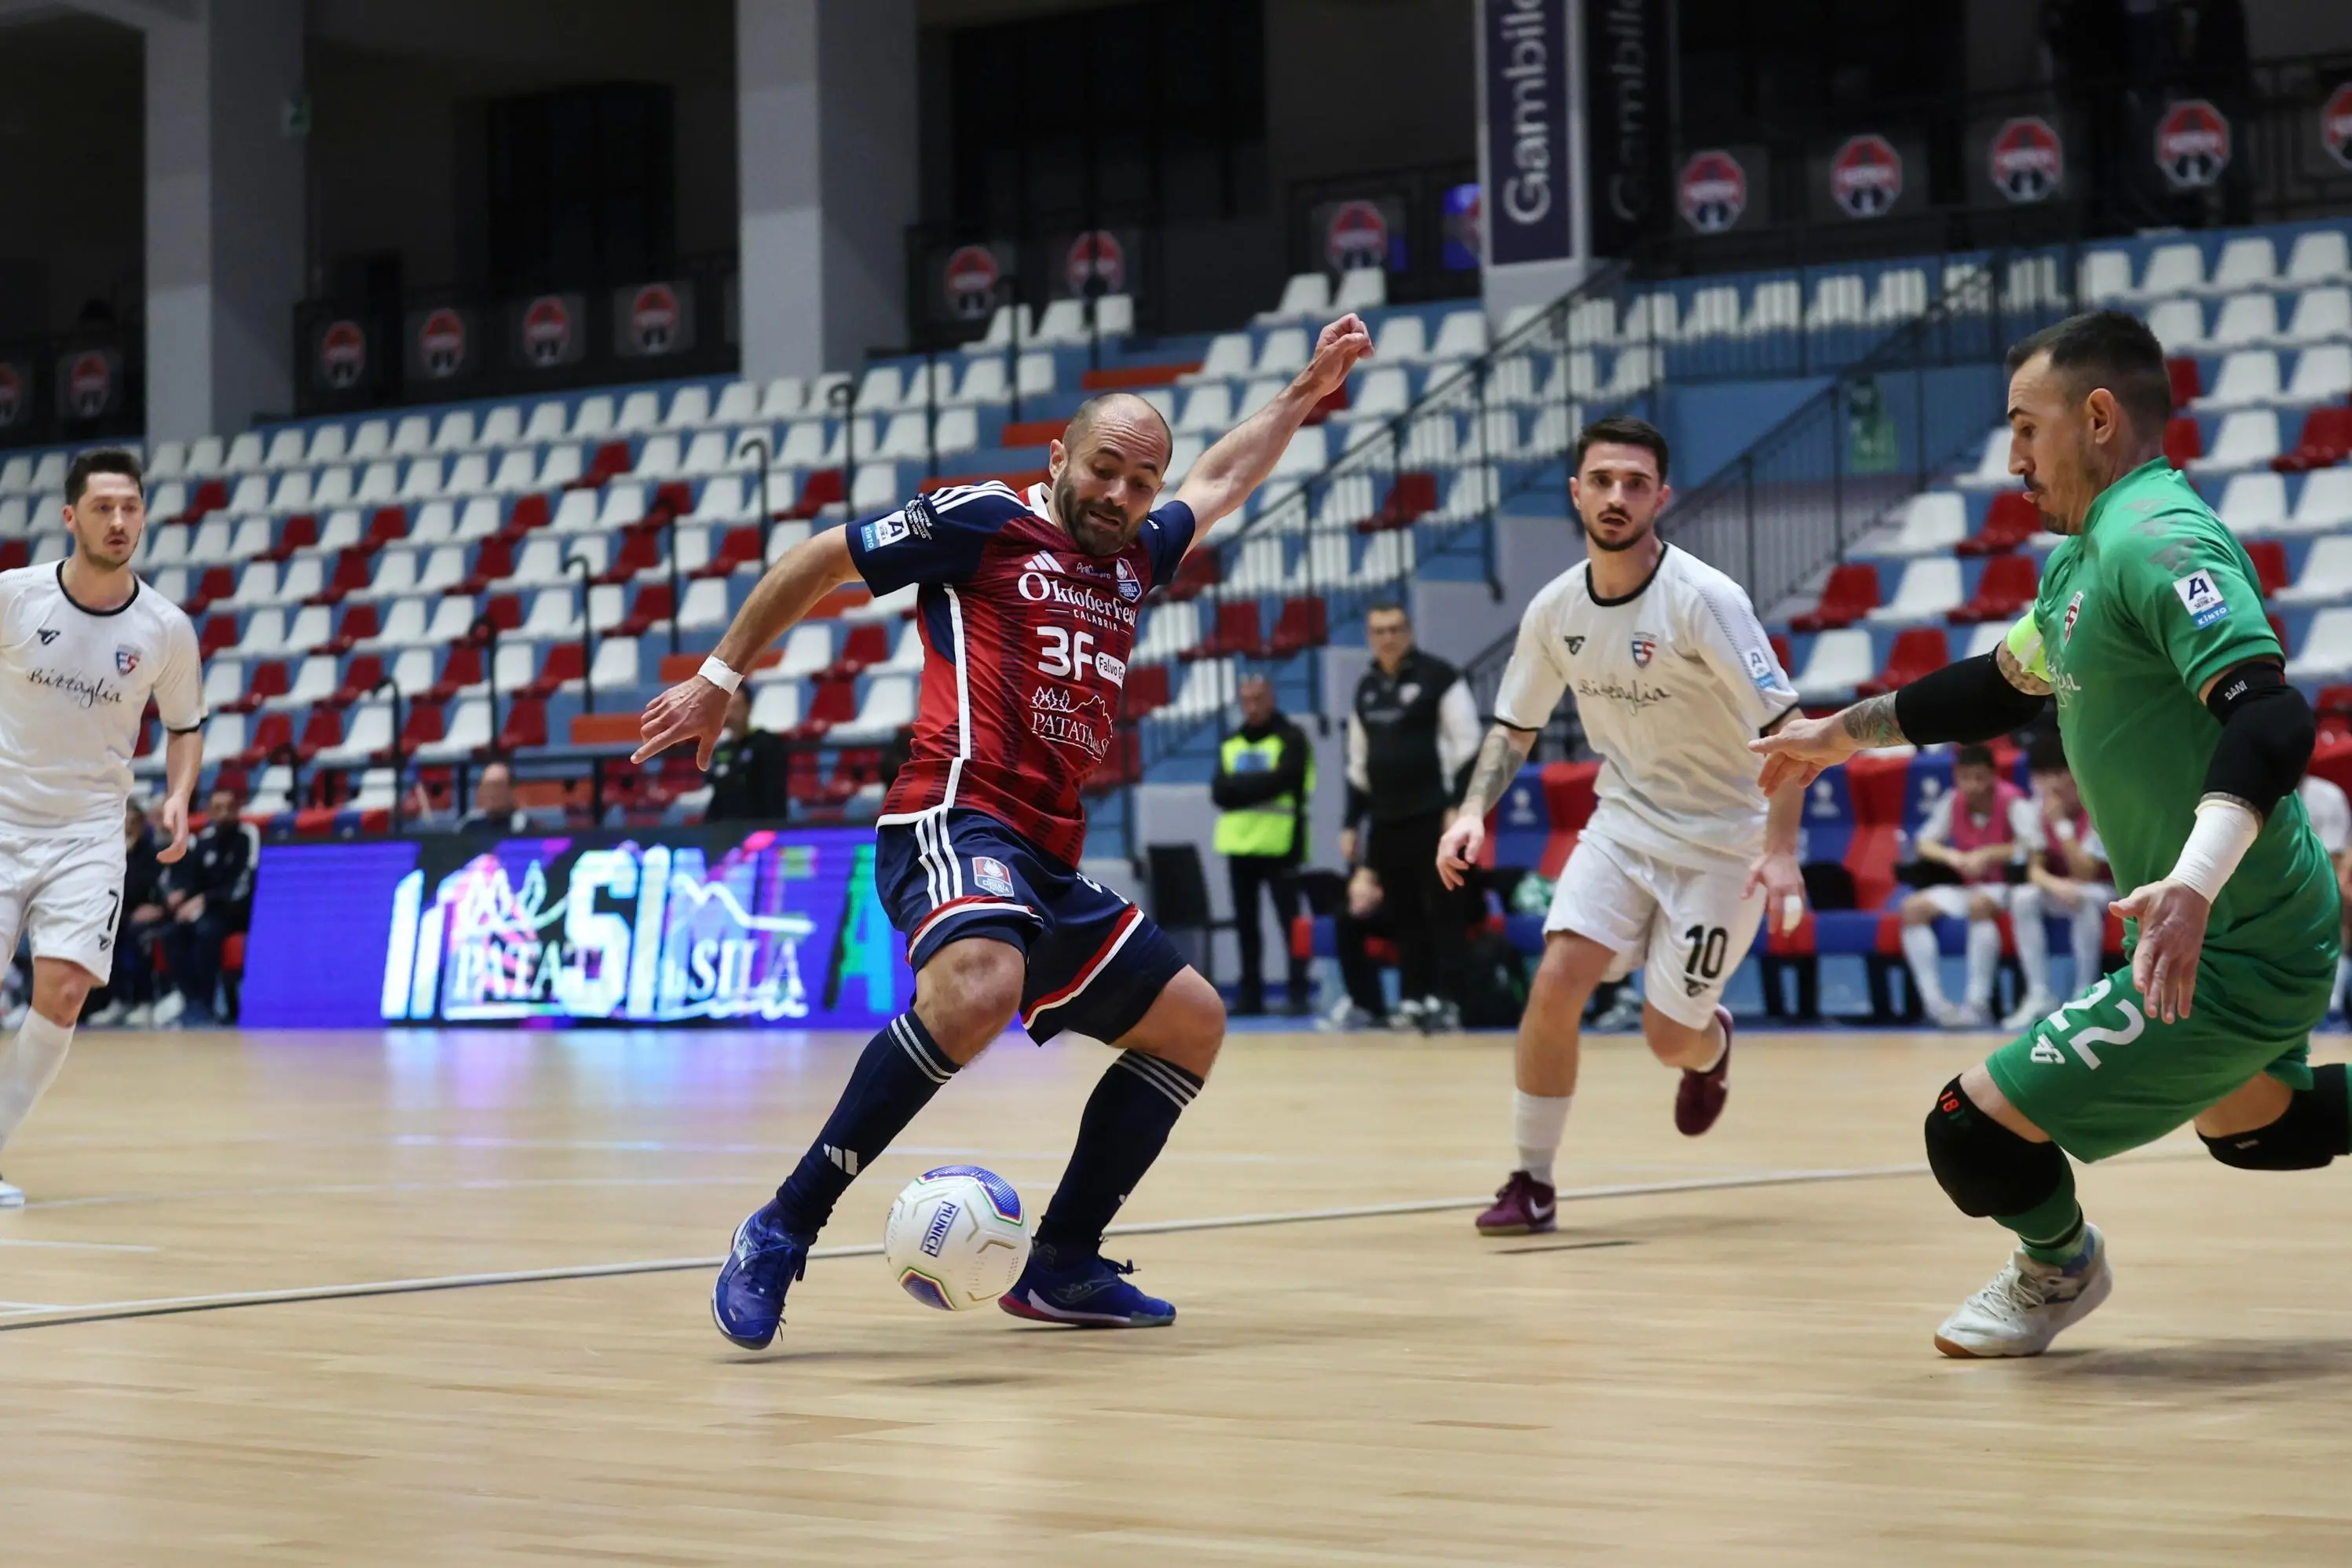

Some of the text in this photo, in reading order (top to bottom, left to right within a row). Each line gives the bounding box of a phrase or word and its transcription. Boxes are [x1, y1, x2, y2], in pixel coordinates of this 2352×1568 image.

[1501, 0, 1552, 225] Gambil
[1073, 609, 1118, 631] CALABRIA
[1037, 626, 1094, 682] 3F
[1099, 656, 1117, 676] Falvo
[1032, 711, 1095, 749] PATATA
[107, 888, 120, 932] 7
[1684, 924, 1729, 979] 10
[2047, 978, 2145, 1071] 22
[923, 1201, 957, 1258] MUNICH
